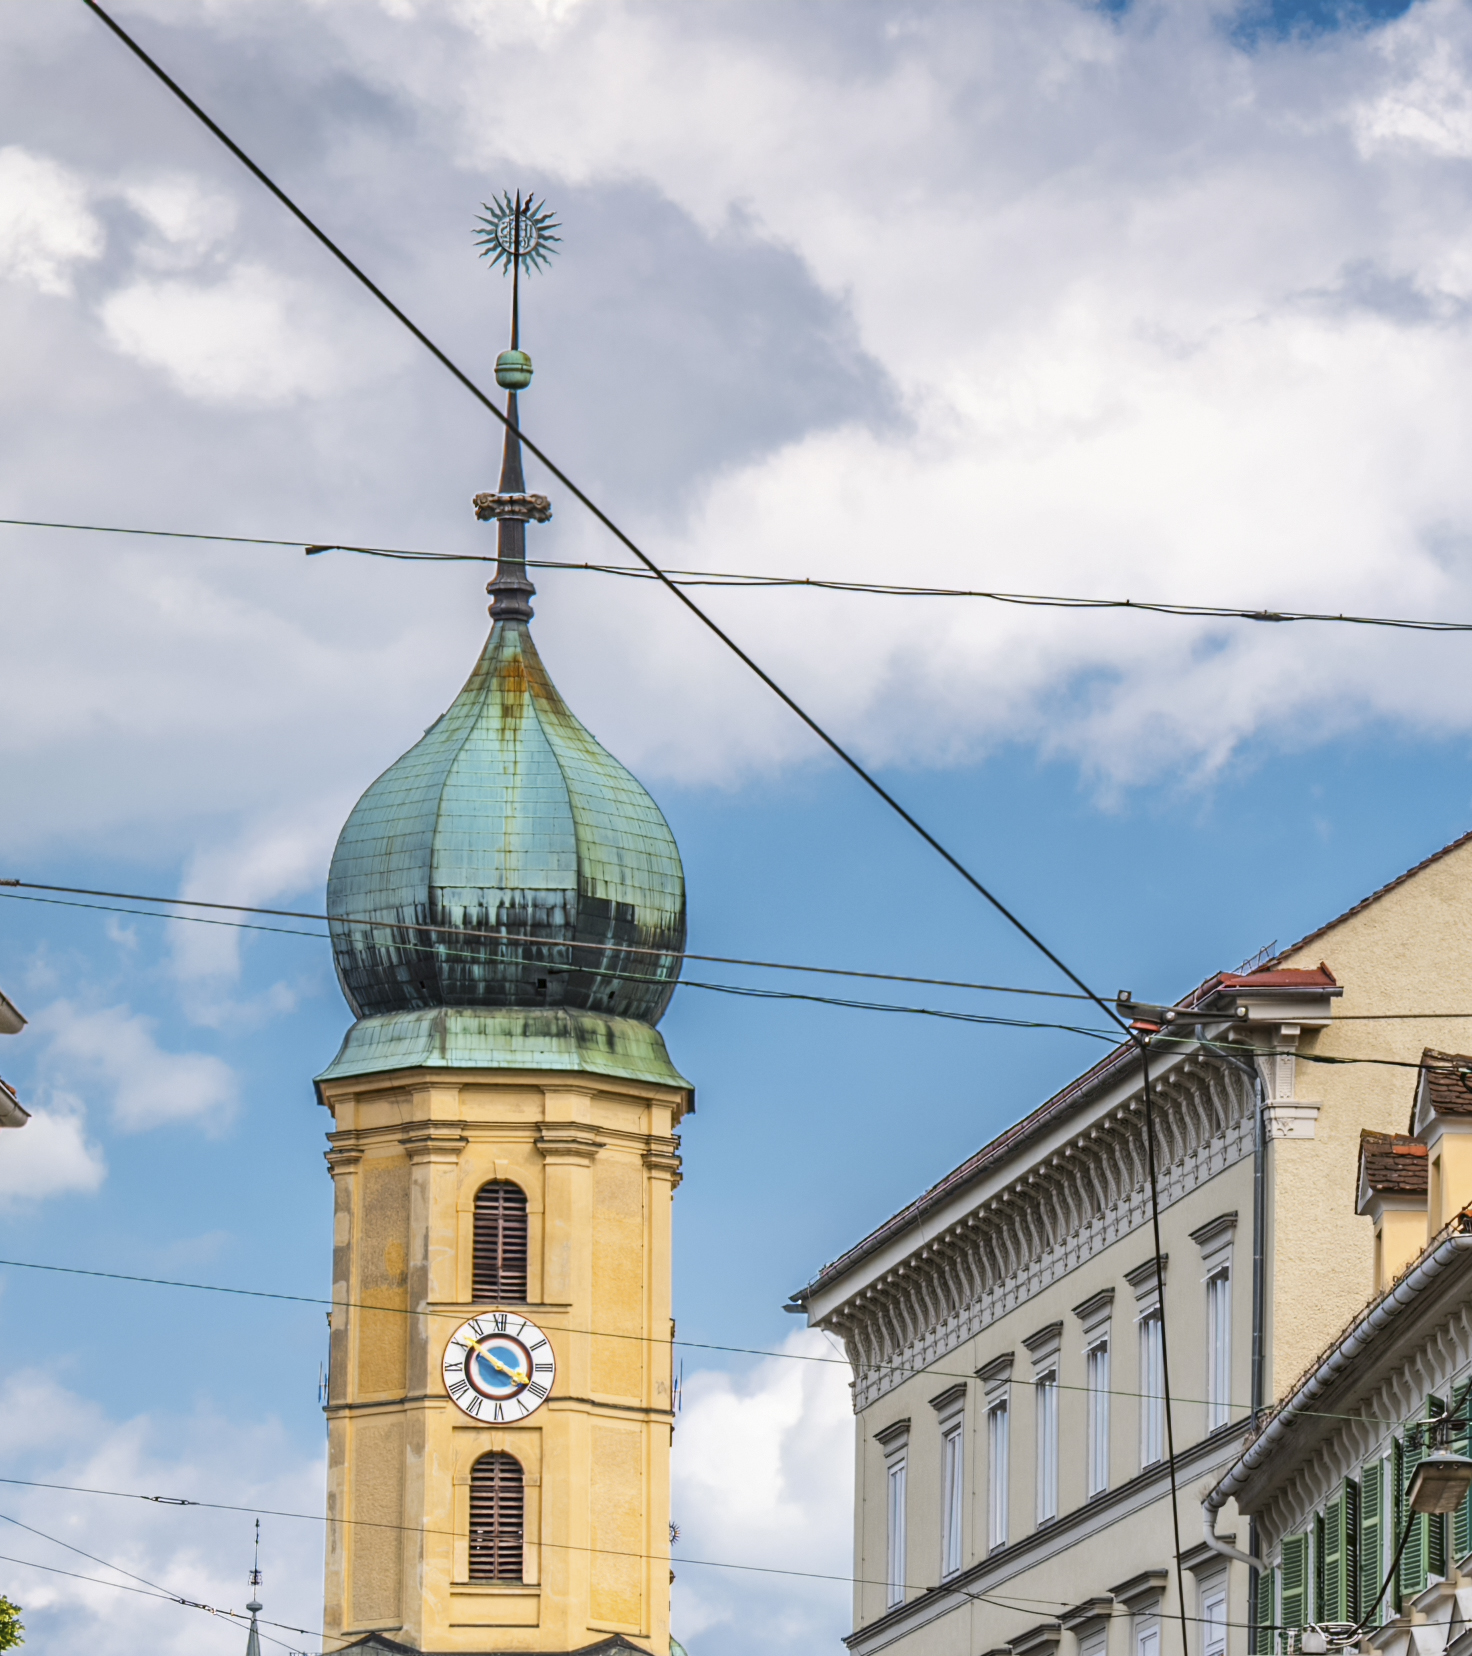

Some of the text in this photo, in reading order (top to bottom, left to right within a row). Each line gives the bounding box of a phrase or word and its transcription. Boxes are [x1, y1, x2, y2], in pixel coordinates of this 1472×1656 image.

[468, 1319, 484, 1338] XI
[493, 1314, 507, 1332] XII
[517, 1321, 526, 1336] I
[530, 1339, 547, 1351] II
[445, 1362, 462, 1372] IX
[535, 1363, 553, 1372] III
[449, 1380, 470, 1401] VIII
[466, 1396, 484, 1416] VII
[494, 1402, 504, 1420] VI
[517, 1398, 530, 1416] V
